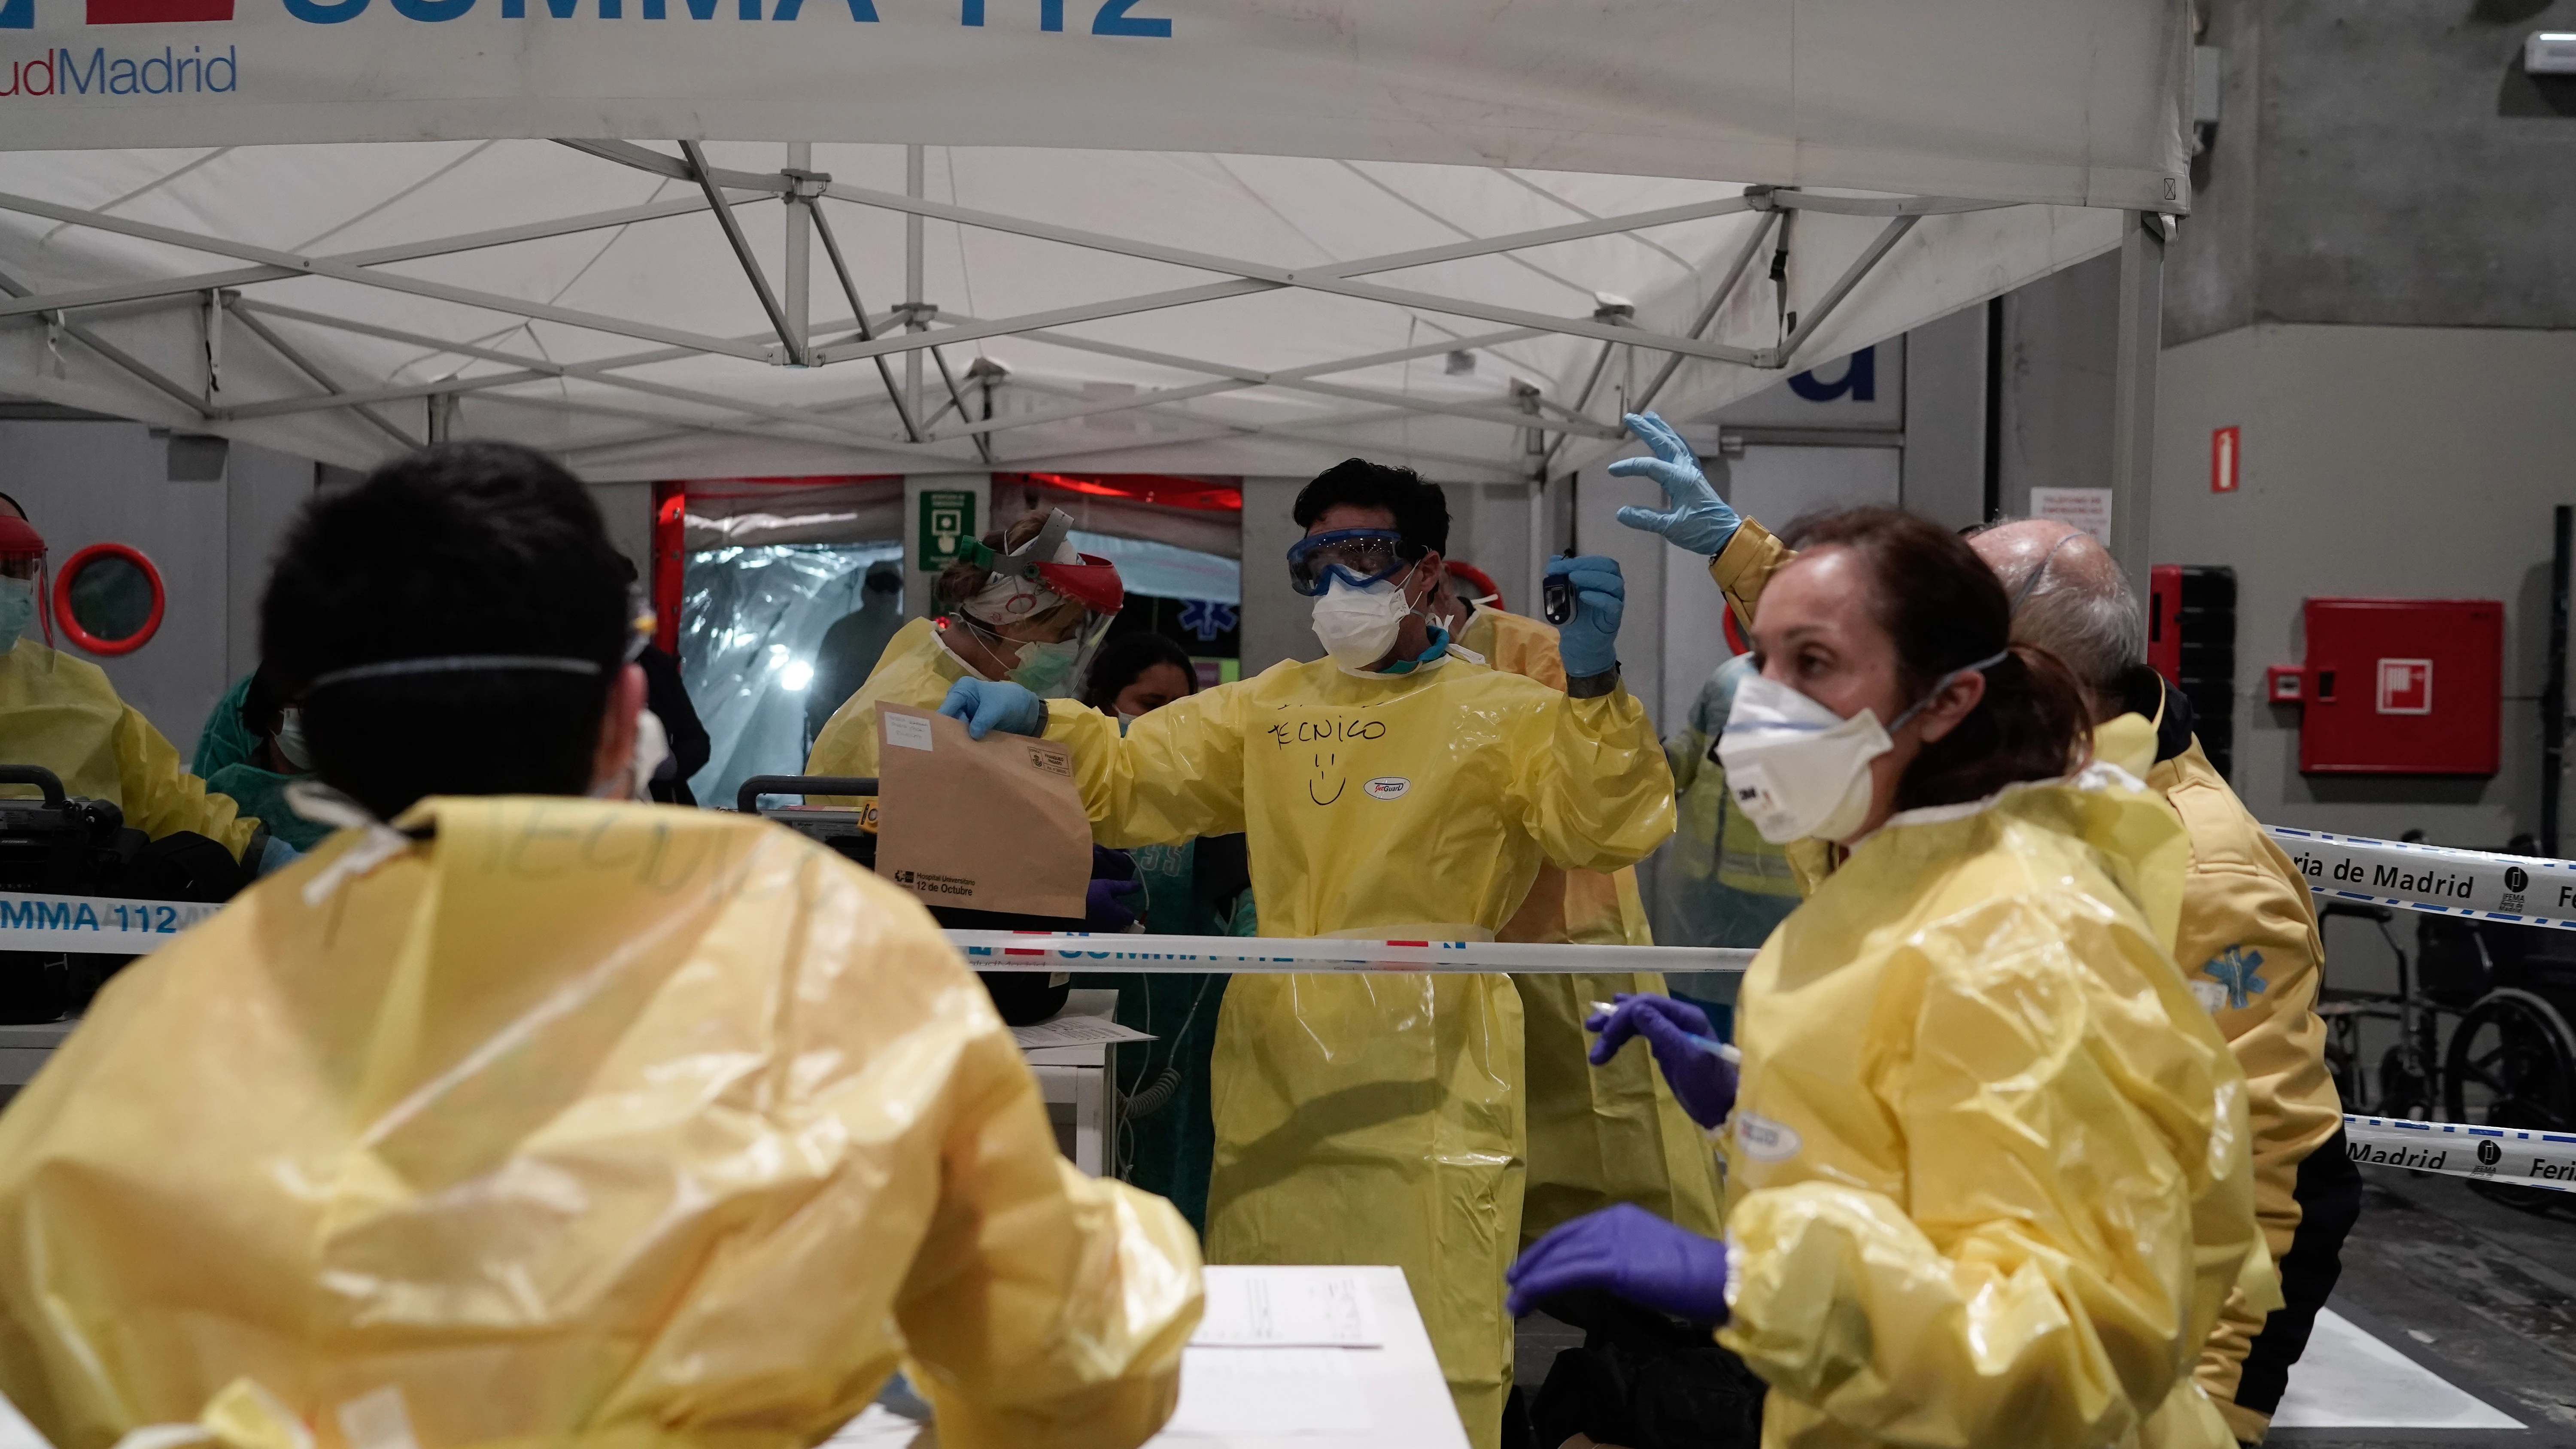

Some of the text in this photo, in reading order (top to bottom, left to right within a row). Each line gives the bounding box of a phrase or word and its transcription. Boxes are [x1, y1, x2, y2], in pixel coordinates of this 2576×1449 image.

[1268, 715, 1385, 750] TECNICO
[917, 872, 975, 886] Hospital Universitario
[917, 881, 926, 890] 12
[929, 882, 939, 892] de
[941, 884, 973, 896] Octubre
[2334, 859, 2364, 883] de
[2373, 865, 2475, 899] Madrid
[2503, 893, 2525, 902] IFEMA
[114, 905, 176, 933] 112
[2347, 1142, 2447, 1169] Madrid
[2529, 1158, 2576, 1181] Feri
